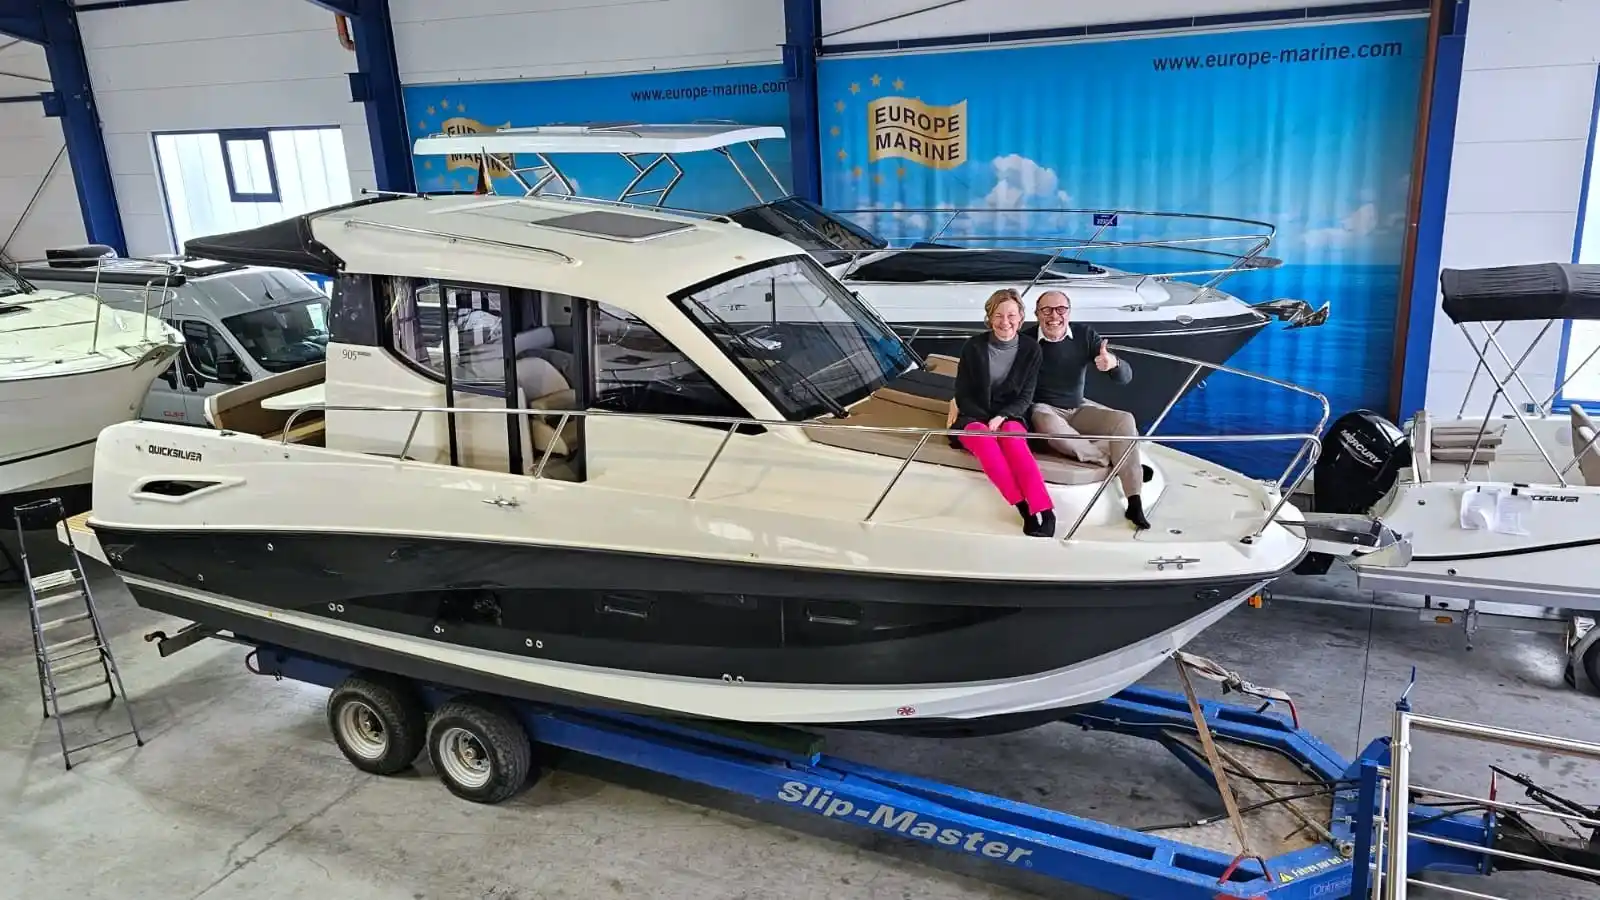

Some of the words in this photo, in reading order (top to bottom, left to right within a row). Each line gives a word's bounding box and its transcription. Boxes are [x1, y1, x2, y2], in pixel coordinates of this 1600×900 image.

[1153, 41, 1403, 72] www.europe-marine.com
[875, 105, 960, 133] EUROPE
[875, 132, 960, 161] MARINE
[342, 349, 357, 361] 905
[148, 444, 203, 463] QUICKSILVER
[1340, 429, 1383, 464] MERCURY
[777, 780, 1034, 863] Slip-Master
